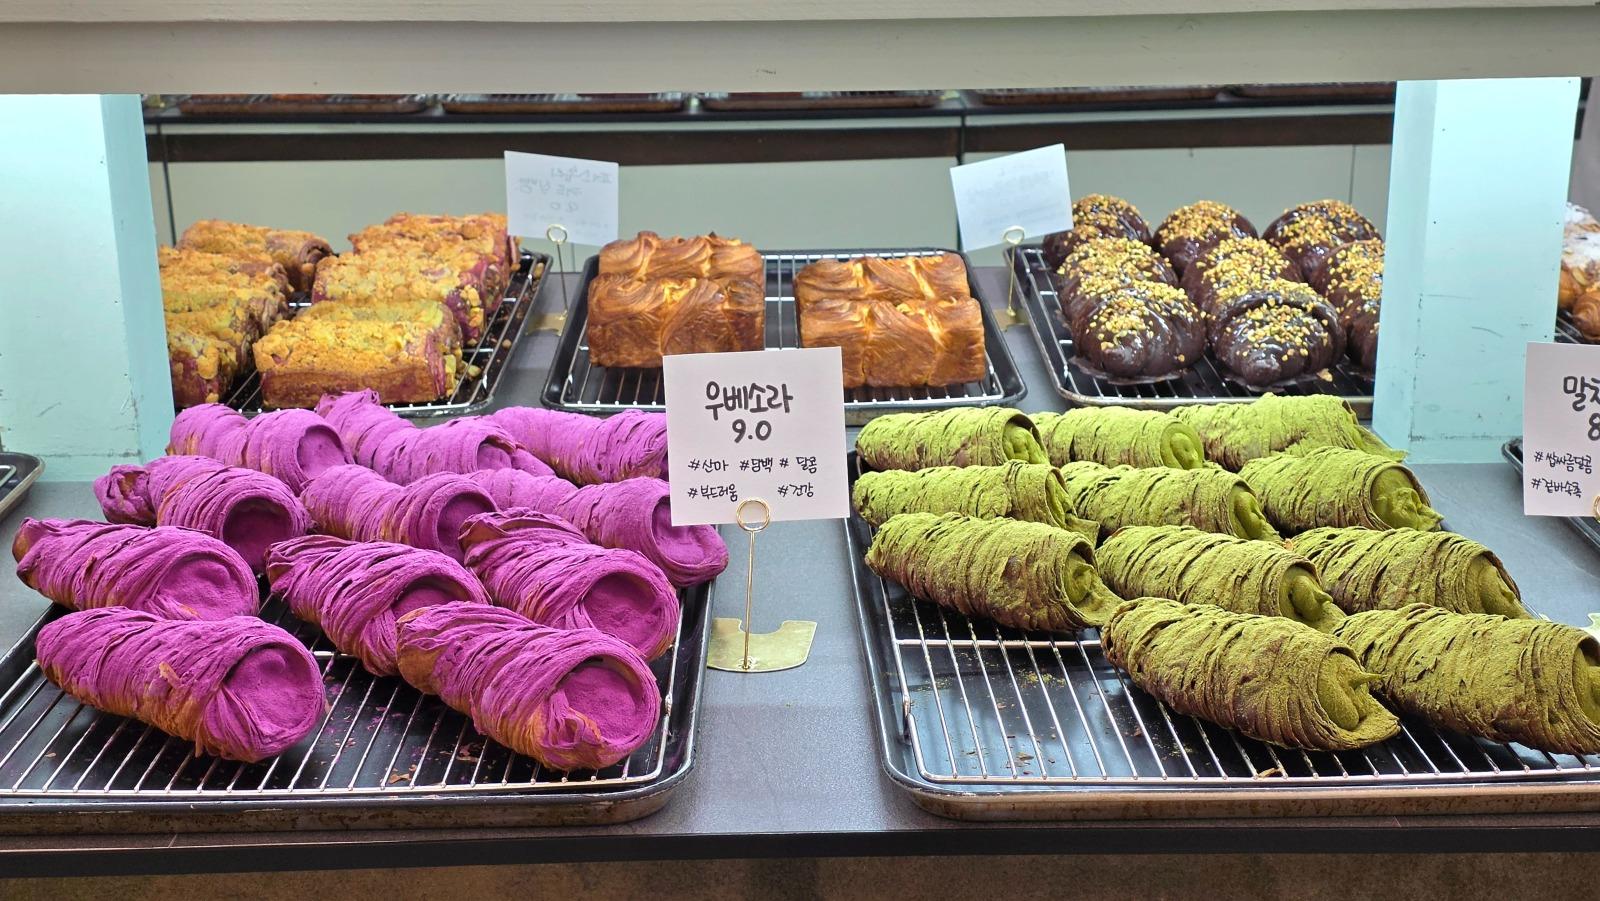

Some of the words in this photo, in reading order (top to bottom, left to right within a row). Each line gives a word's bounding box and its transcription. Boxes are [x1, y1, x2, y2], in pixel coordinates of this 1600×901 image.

[704, 380, 794, 421] 우베소라
[731, 418, 772, 444] 9.0
[739, 457, 774, 473] #담백
[777, 482, 814, 498] #건강
